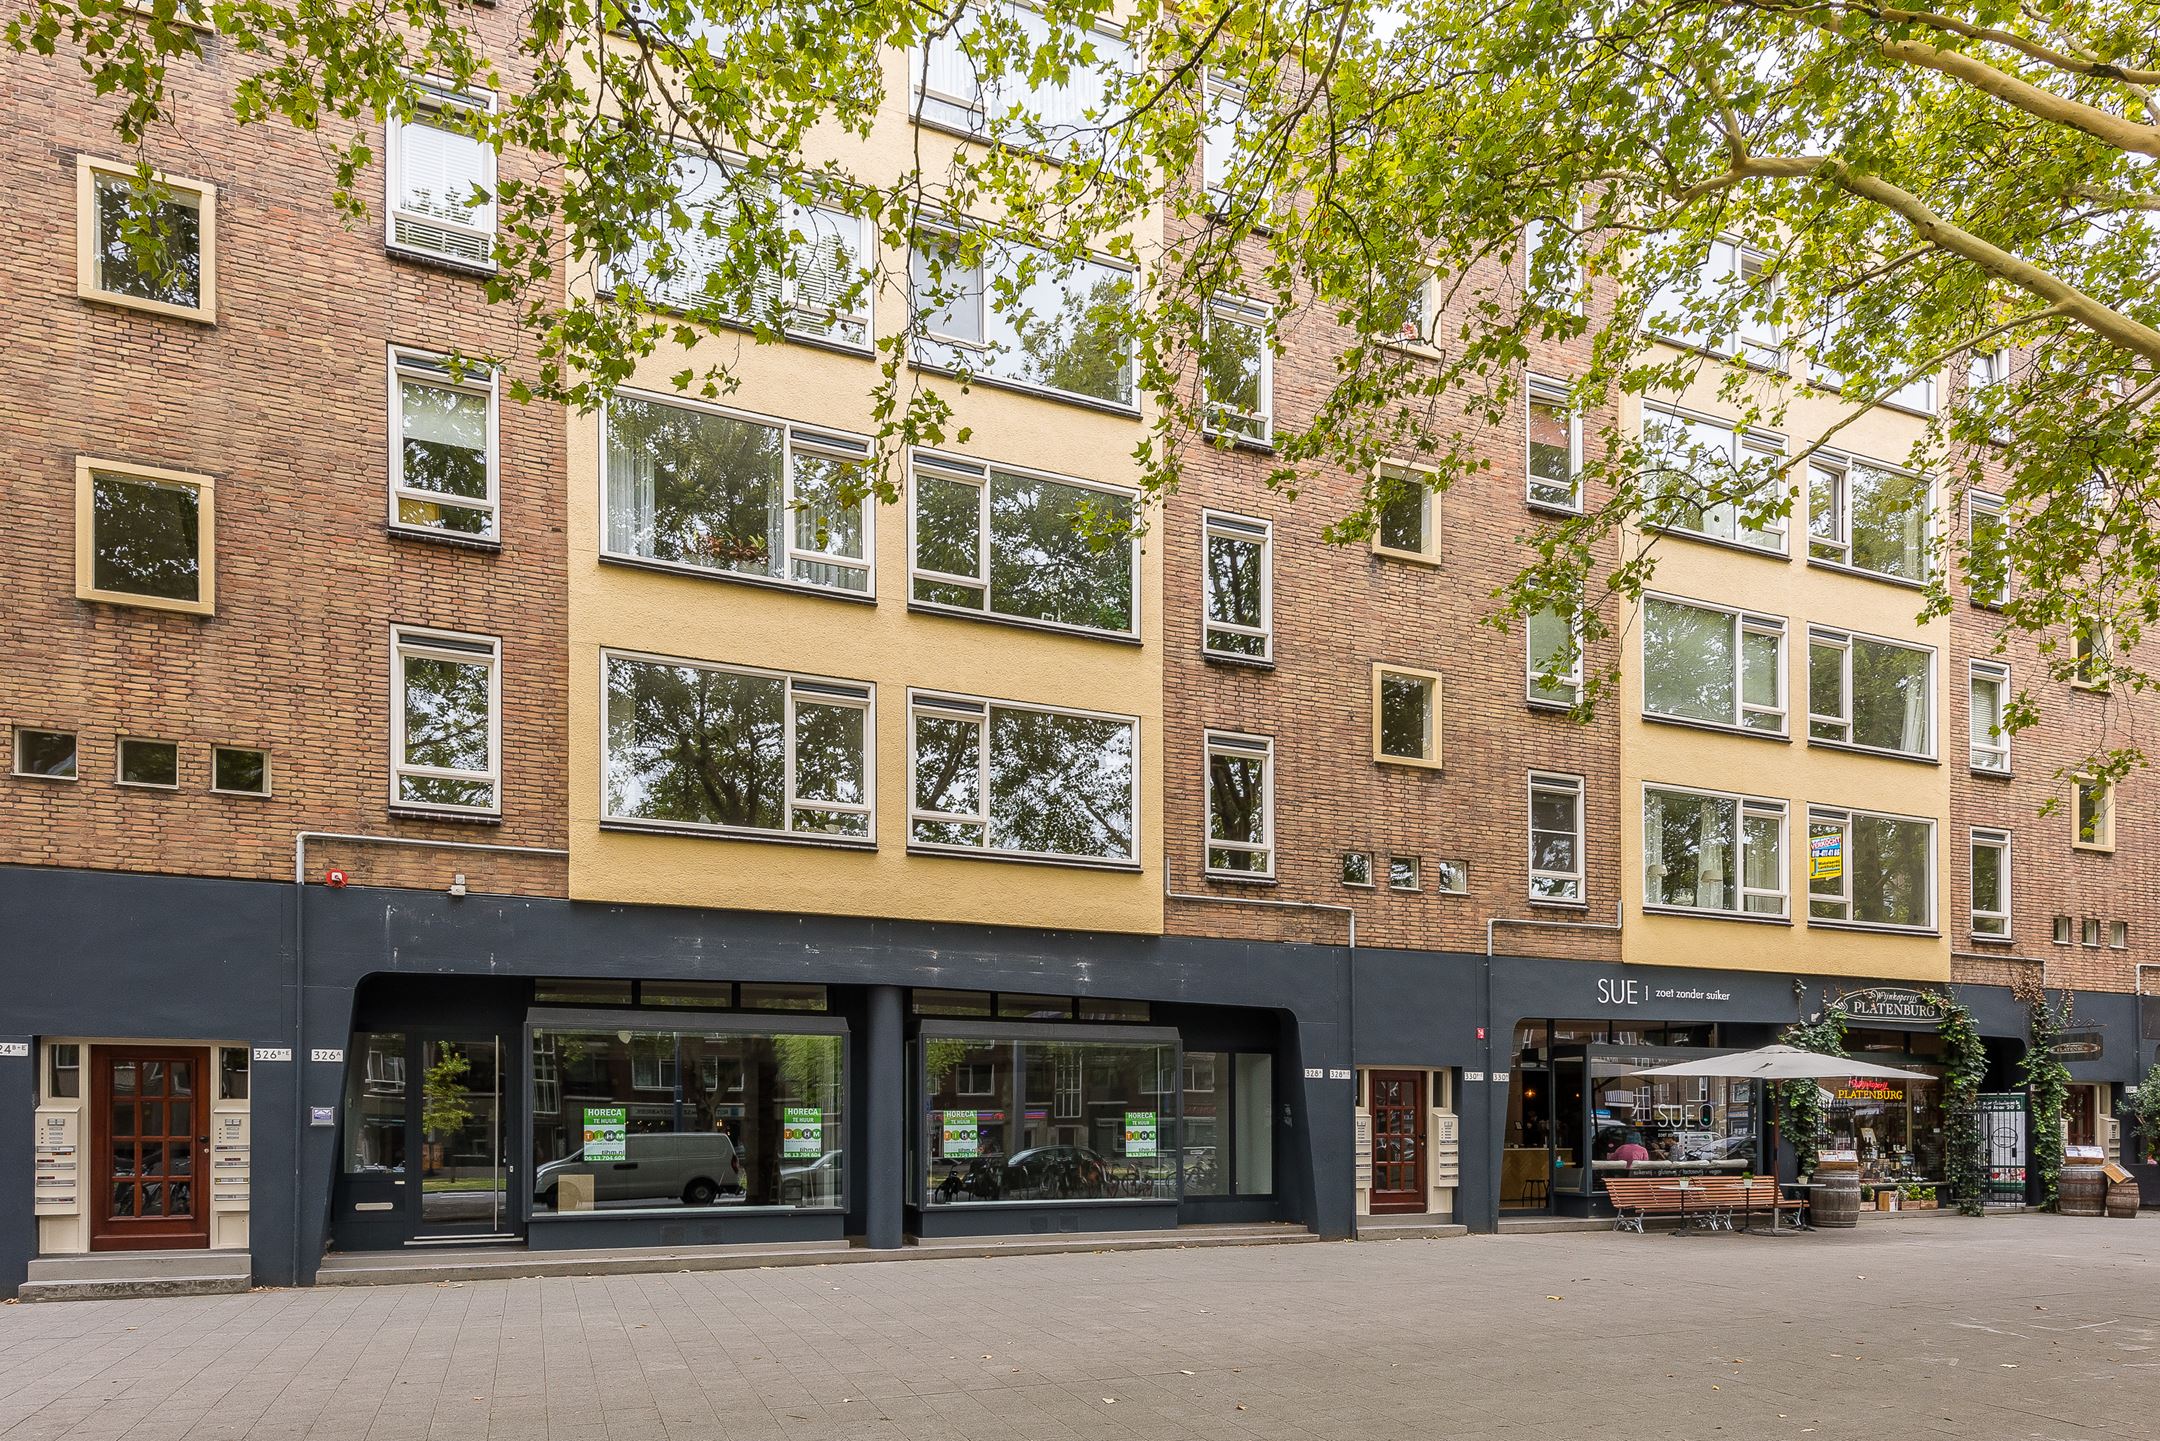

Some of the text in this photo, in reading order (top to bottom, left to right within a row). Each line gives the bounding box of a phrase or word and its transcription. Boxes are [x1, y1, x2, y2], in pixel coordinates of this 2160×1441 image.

[1811, 836, 1840, 849] VERKOCHT
[1597, 978, 1638, 1005] SUE
[1655, 988, 1730, 1000] zoet zonder suiker
[1853, 1001, 1935, 1017] PLATENBURG
[1837, 1089, 1903, 1100] PLATENBURG
[1658, 1104, 1695, 1128] SUE
